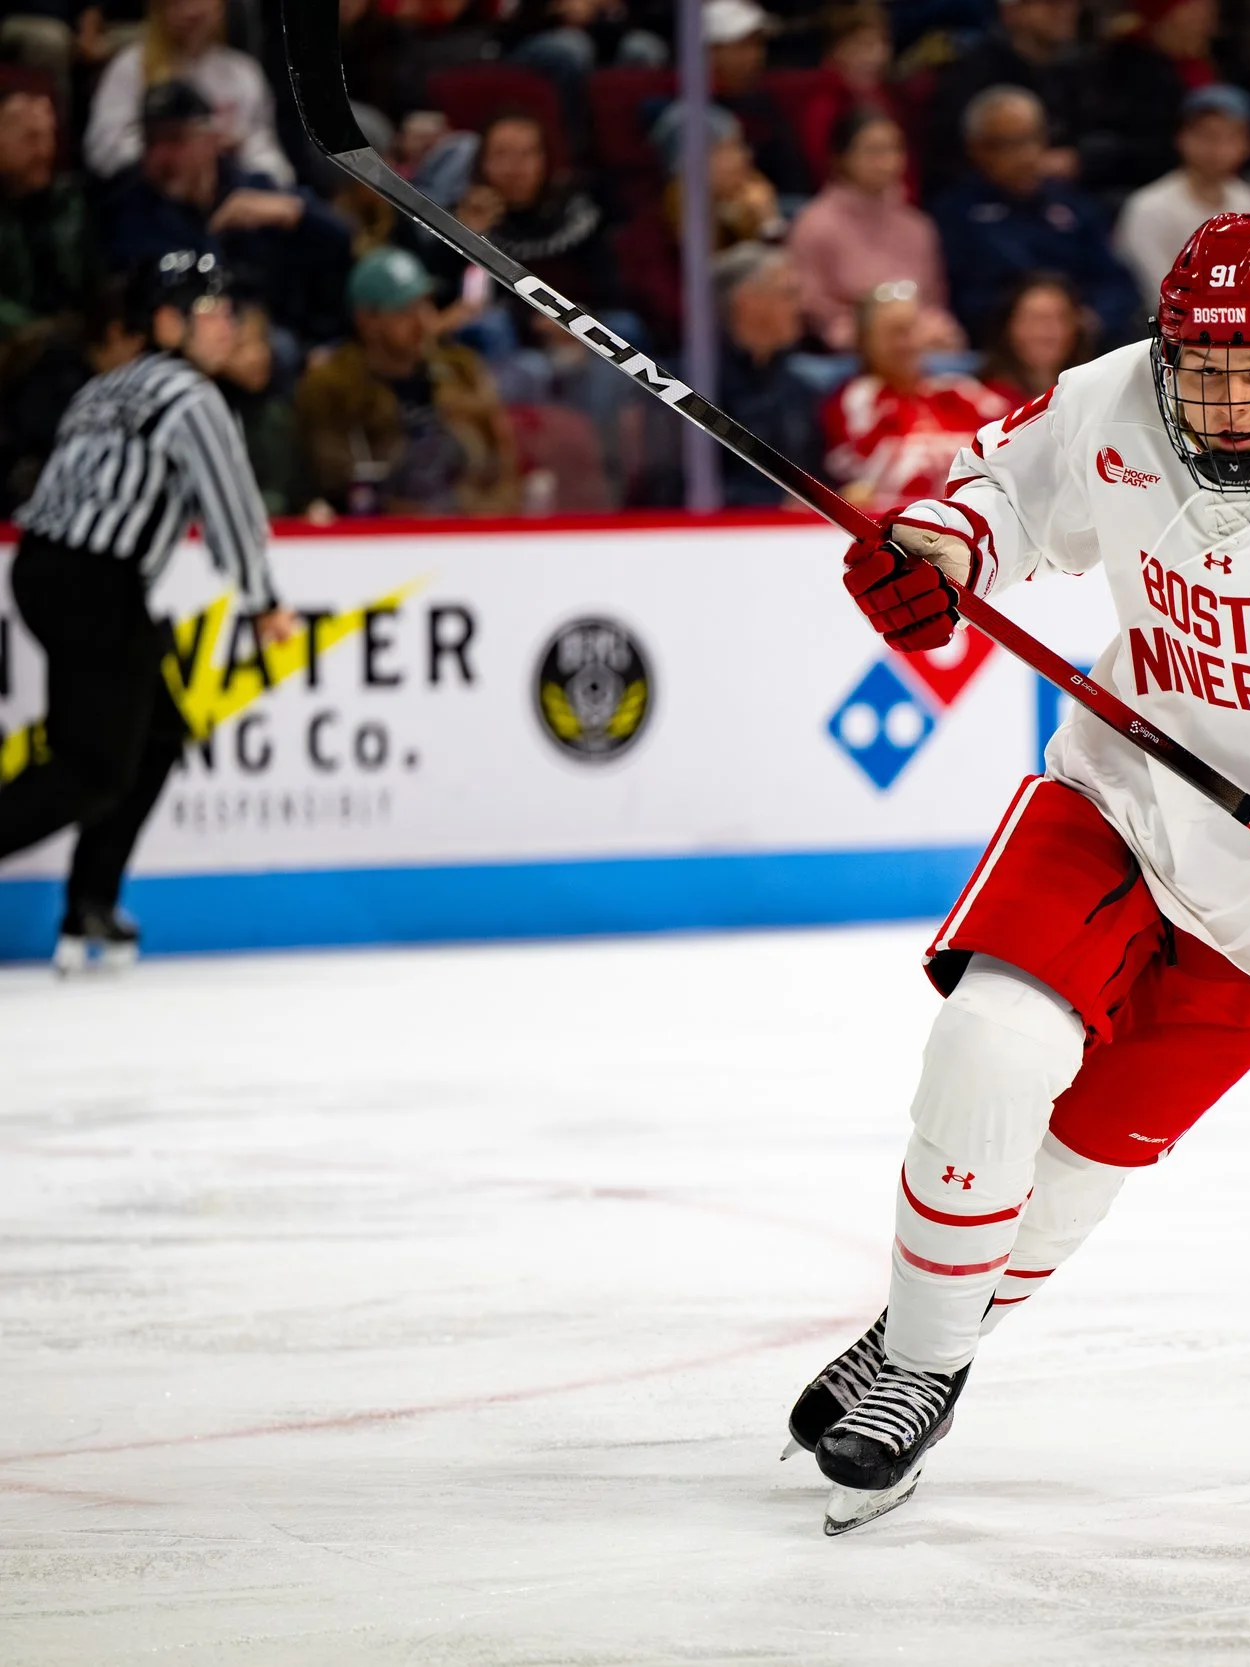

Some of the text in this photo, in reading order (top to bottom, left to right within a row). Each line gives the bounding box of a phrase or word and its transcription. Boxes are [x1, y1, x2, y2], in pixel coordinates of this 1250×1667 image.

[1209, 265, 1236, 287] 91
[1193, 307, 1246, 323] BOSTON
[513, 275, 694, 404] CCM
[1124, 467, 1161, 484] HOCKEY
[1081, 683, 1098, 696] PRO
[306, 710, 416, 773] Co.
